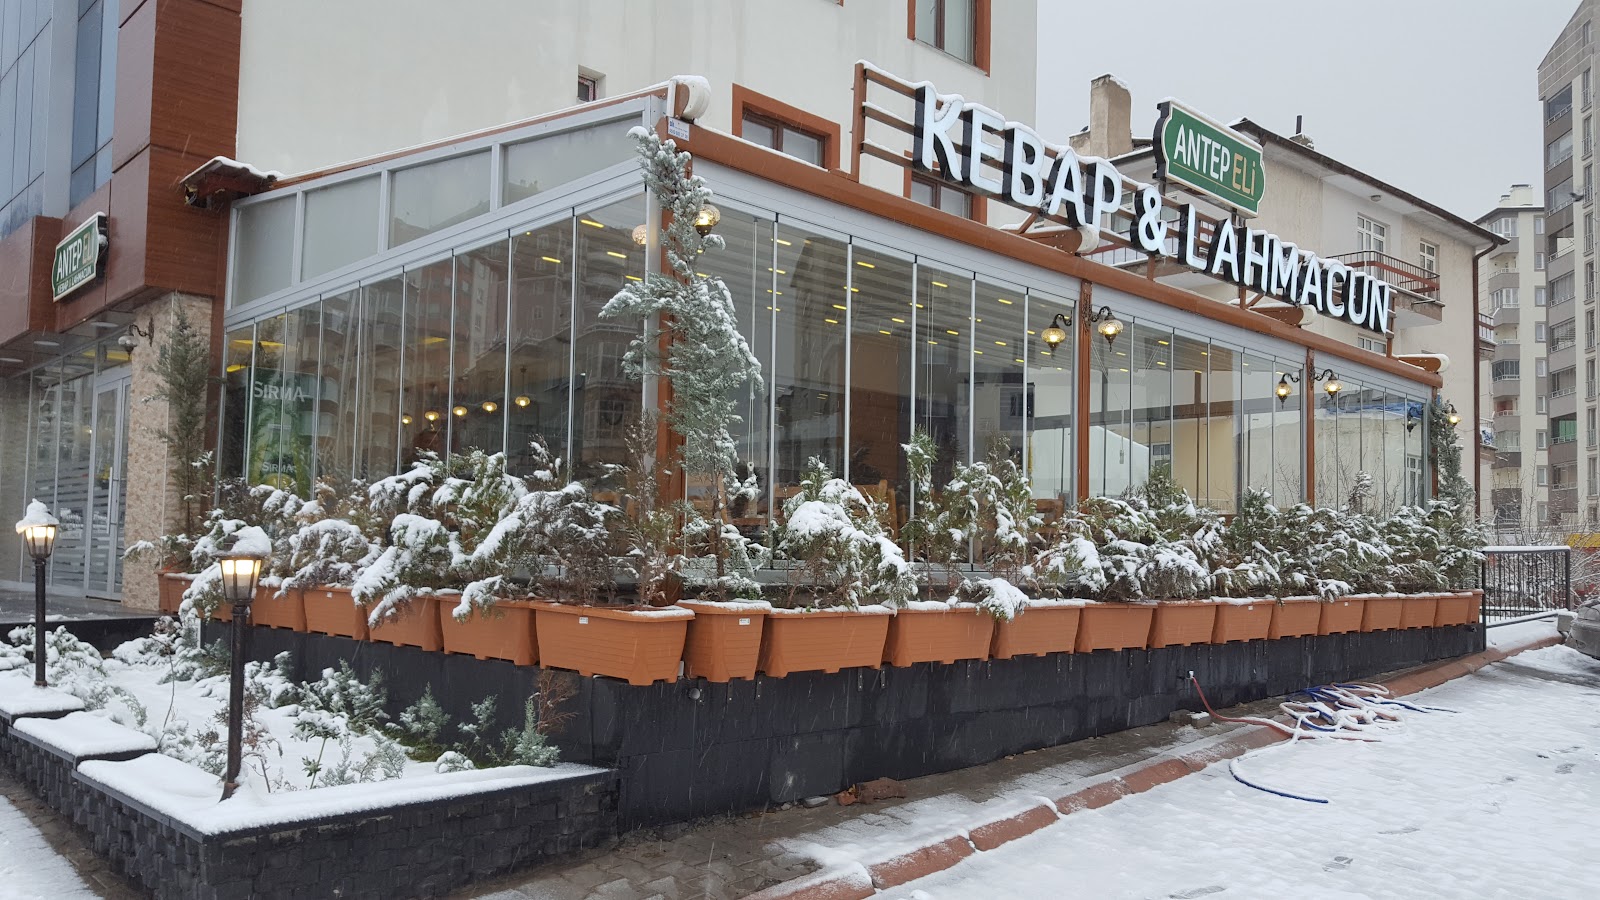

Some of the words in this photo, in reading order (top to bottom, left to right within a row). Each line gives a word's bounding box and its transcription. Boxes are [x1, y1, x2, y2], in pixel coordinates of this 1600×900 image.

[1173, 123, 1231, 183] ANTEP
[917, 84, 1123, 232] KEBAP
[1137, 187, 1168, 256] &
[1184, 202, 1390, 335] LAHMACUN
[56, 238, 83, 282] ANTEP
[254, 380, 305, 402] SIRMA
